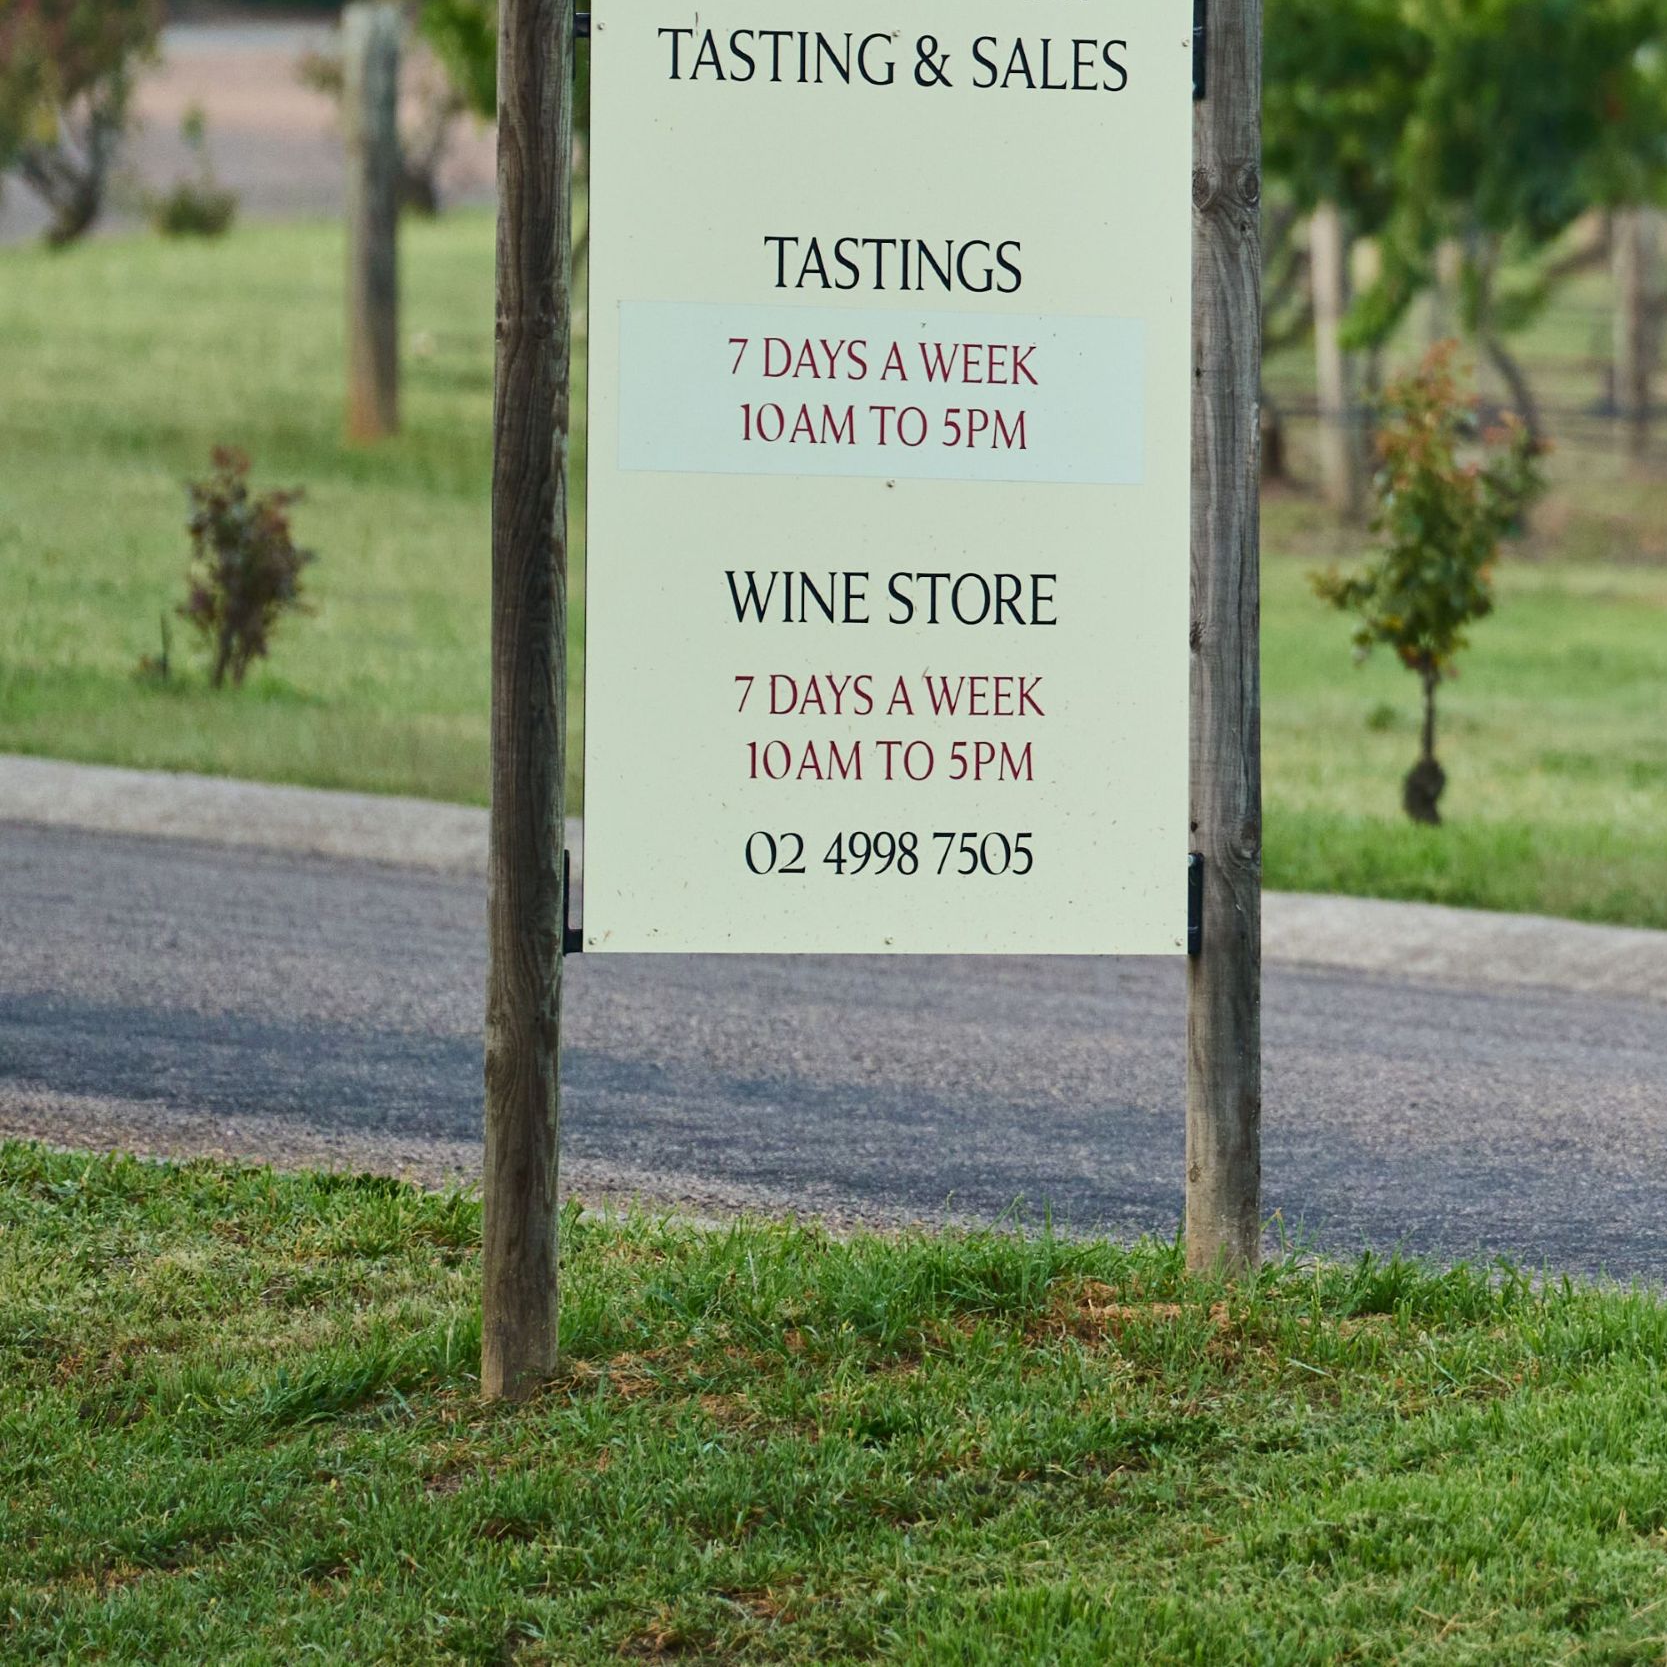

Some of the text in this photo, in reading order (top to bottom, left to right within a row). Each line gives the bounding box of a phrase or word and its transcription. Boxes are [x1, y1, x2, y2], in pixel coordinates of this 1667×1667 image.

[657, 27, 1128, 93] TASTING & SALES
[763, 235, 1023, 294] TASTINGS
[728, 337, 1039, 386] 7 DAYS A WEEK
[739, 402, 1028, 451] 10AM TO 5PM
[723, 569, 1058, 626] WINE STORE
[734, 672, 1046, 717] 7 DAYS A WEEK
[745, 739, 1034, 782] 10AM TO 5PM
[744, 830, 1034, 876] 02 4998 7505
